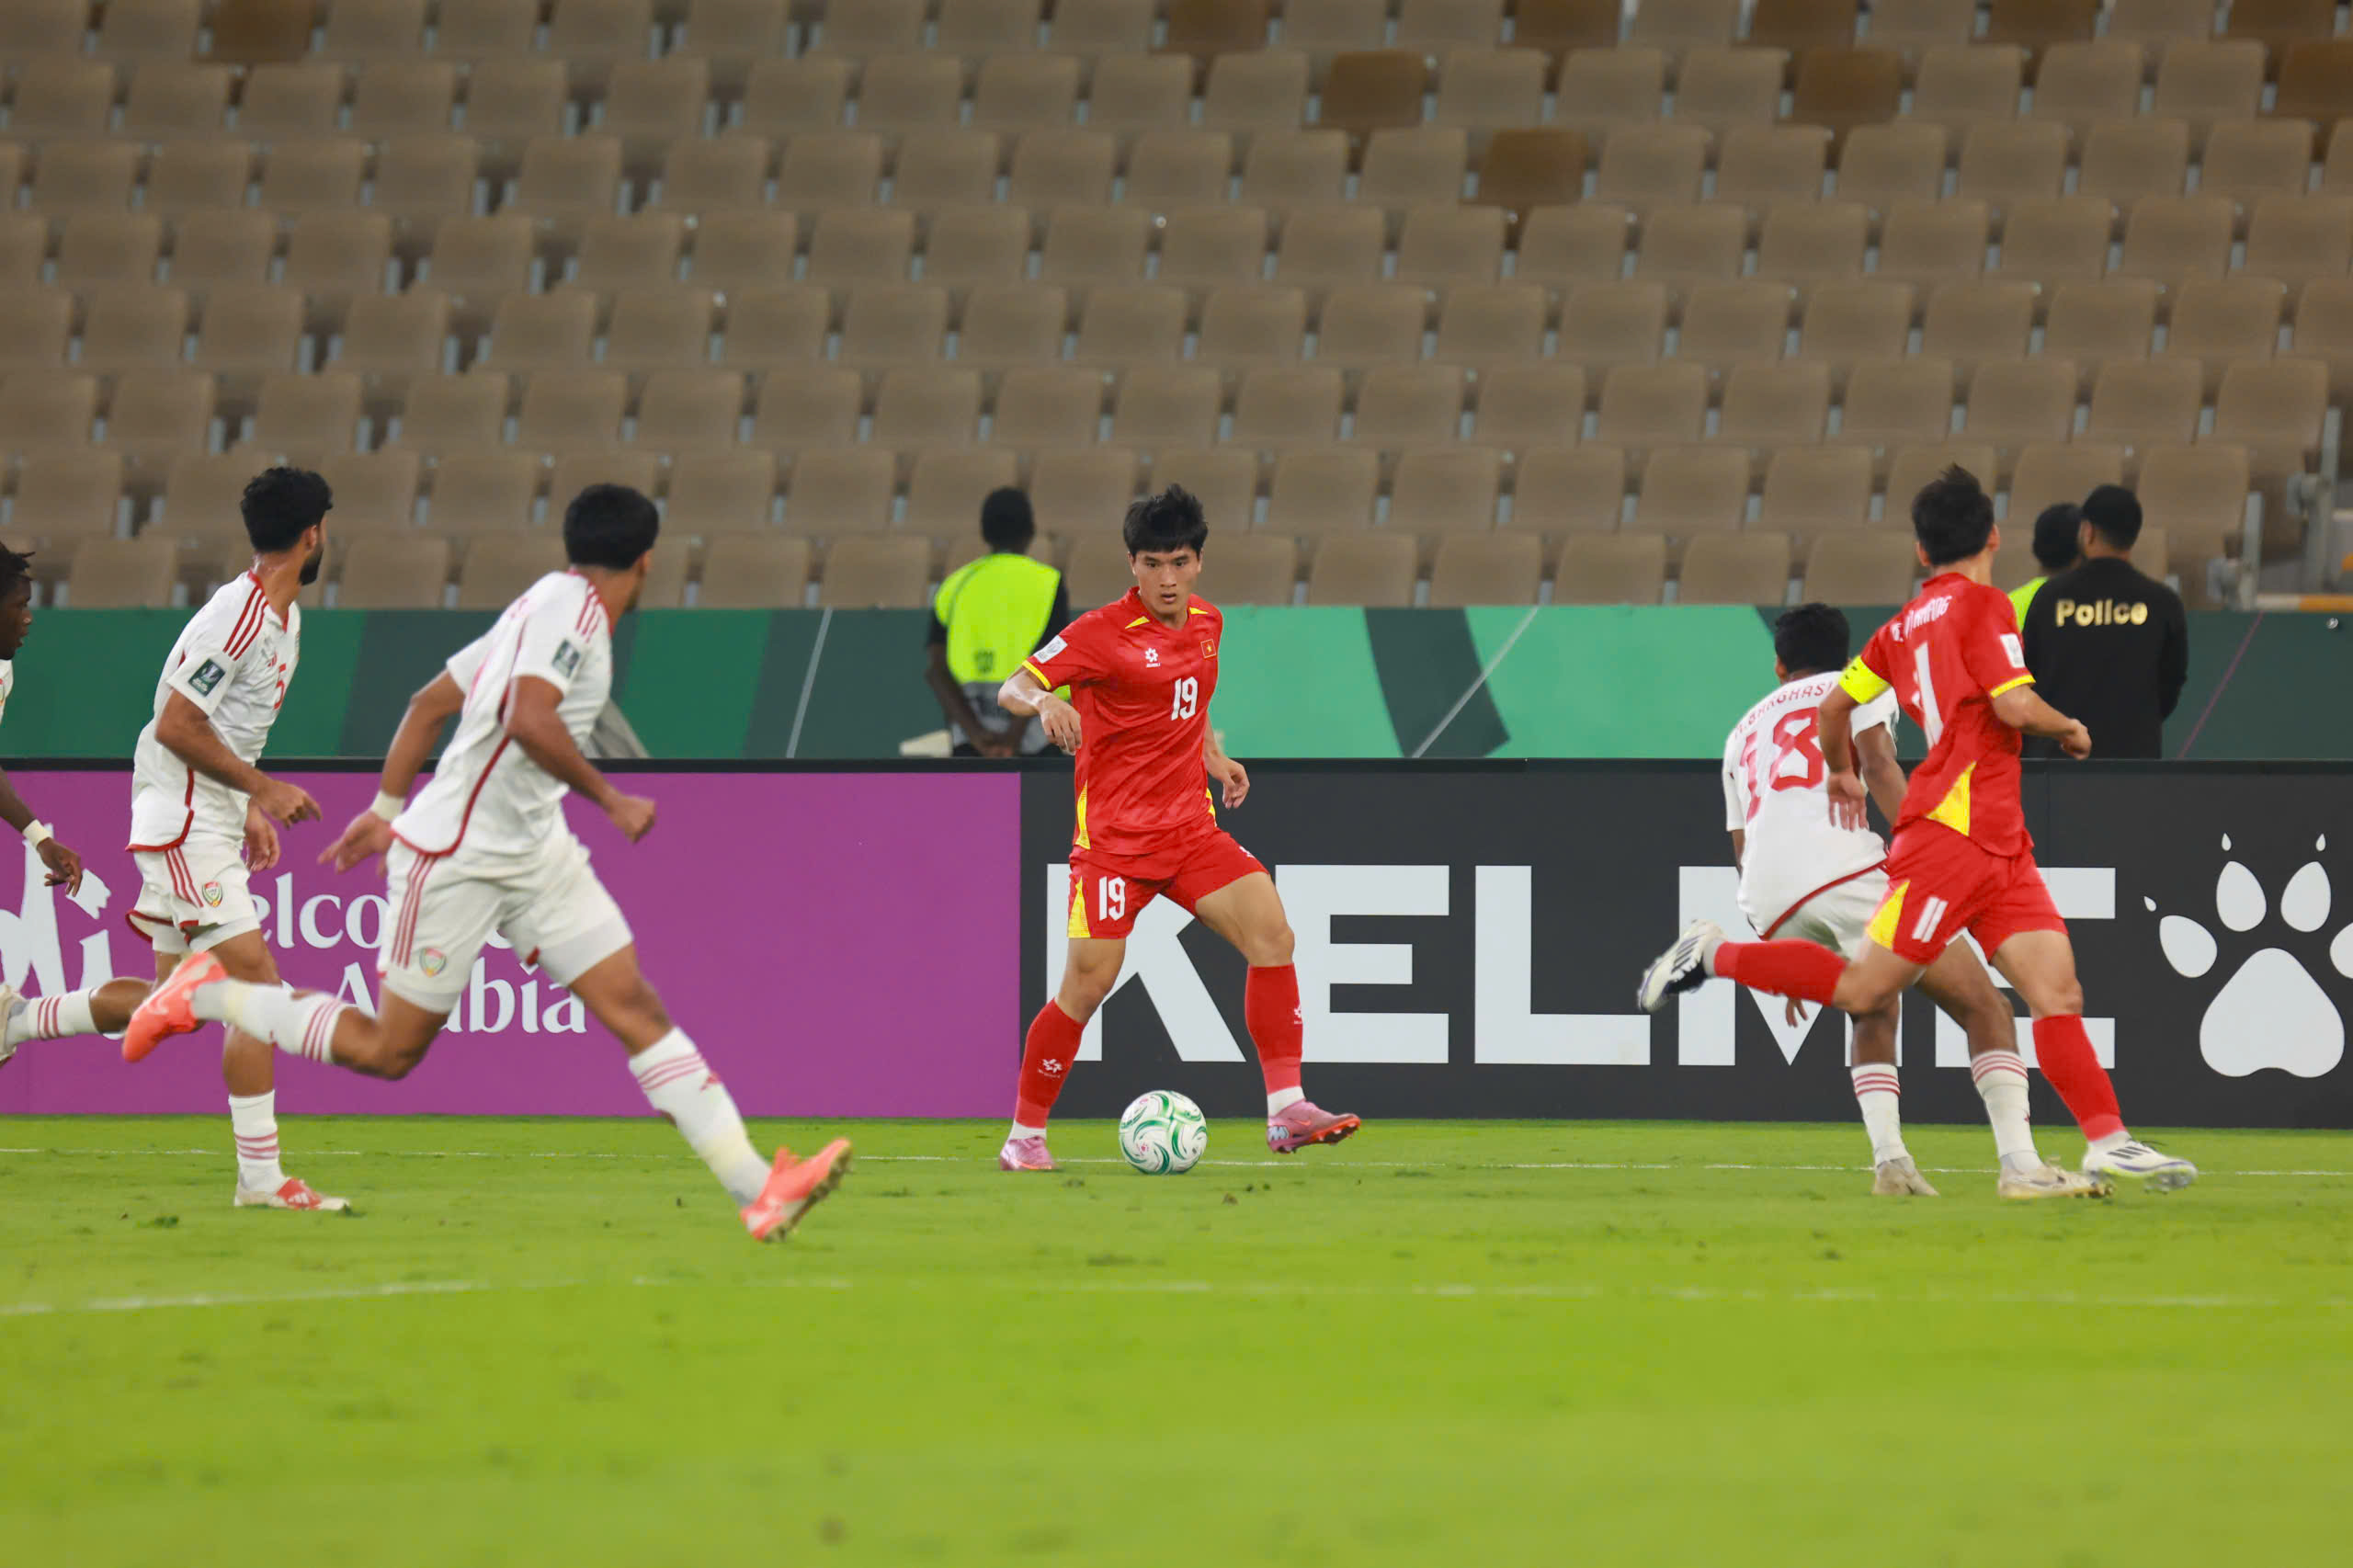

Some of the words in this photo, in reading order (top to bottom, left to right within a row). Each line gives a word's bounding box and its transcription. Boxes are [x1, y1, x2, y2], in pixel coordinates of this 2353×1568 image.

[1171, 676, 1199, 722] 19
[1739, 706, 1824, 824] 18
[1098, 876, 1126, 921] 19
[1912, 896, 1949, 943] 11
